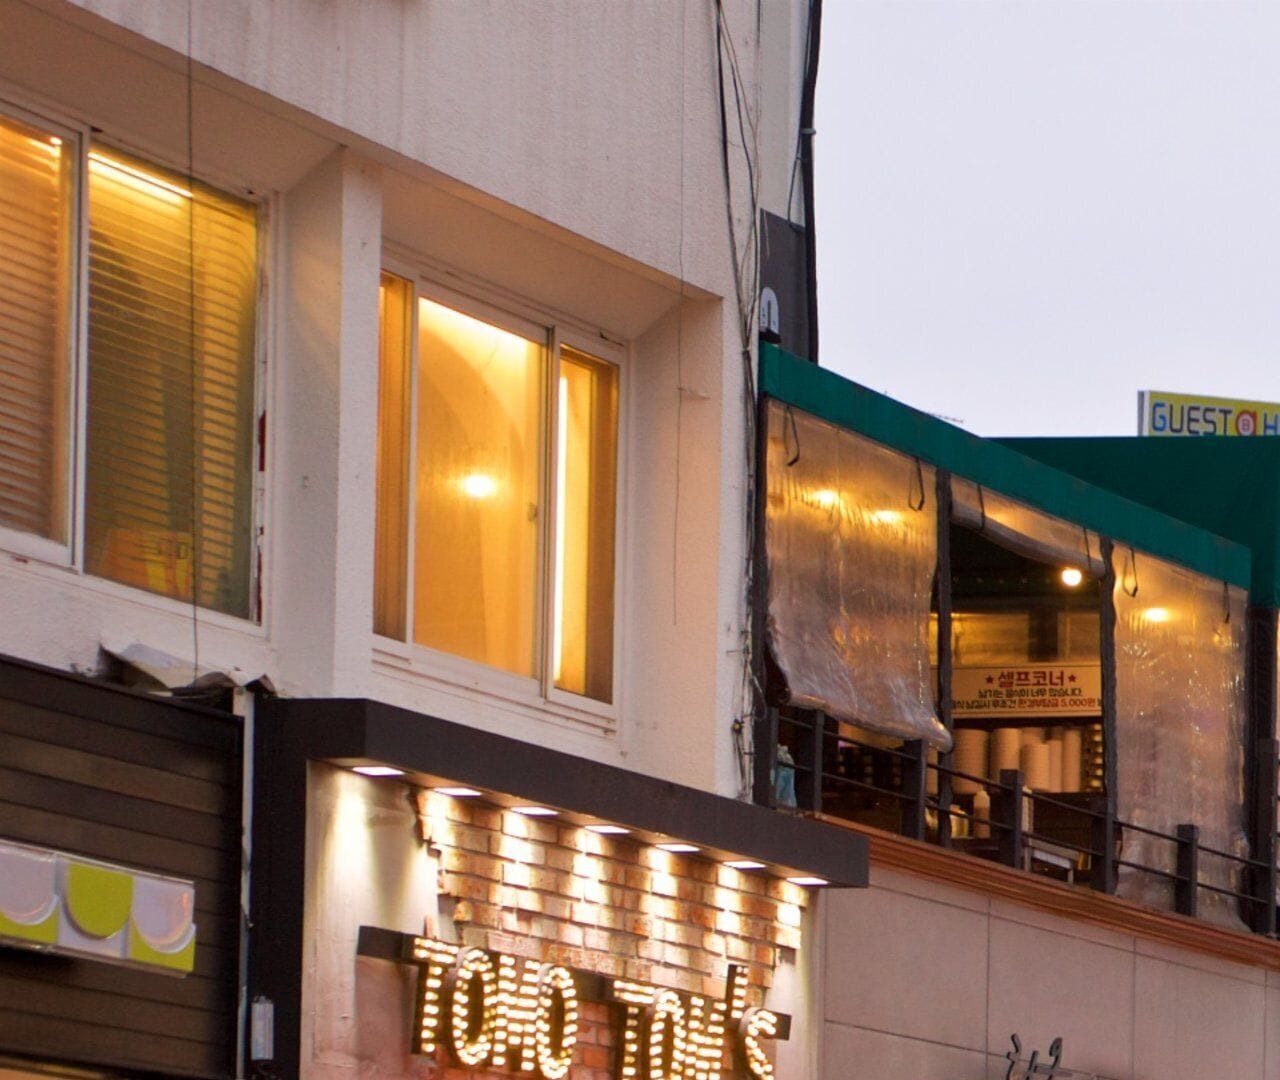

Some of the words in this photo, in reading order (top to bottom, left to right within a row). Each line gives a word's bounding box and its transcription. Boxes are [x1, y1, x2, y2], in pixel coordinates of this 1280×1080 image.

[1151, 402, 1233, 437] GUEST
[998, 670, 1064, 688] 셀프코너
[412, 936, 579, 1080] TOMO
